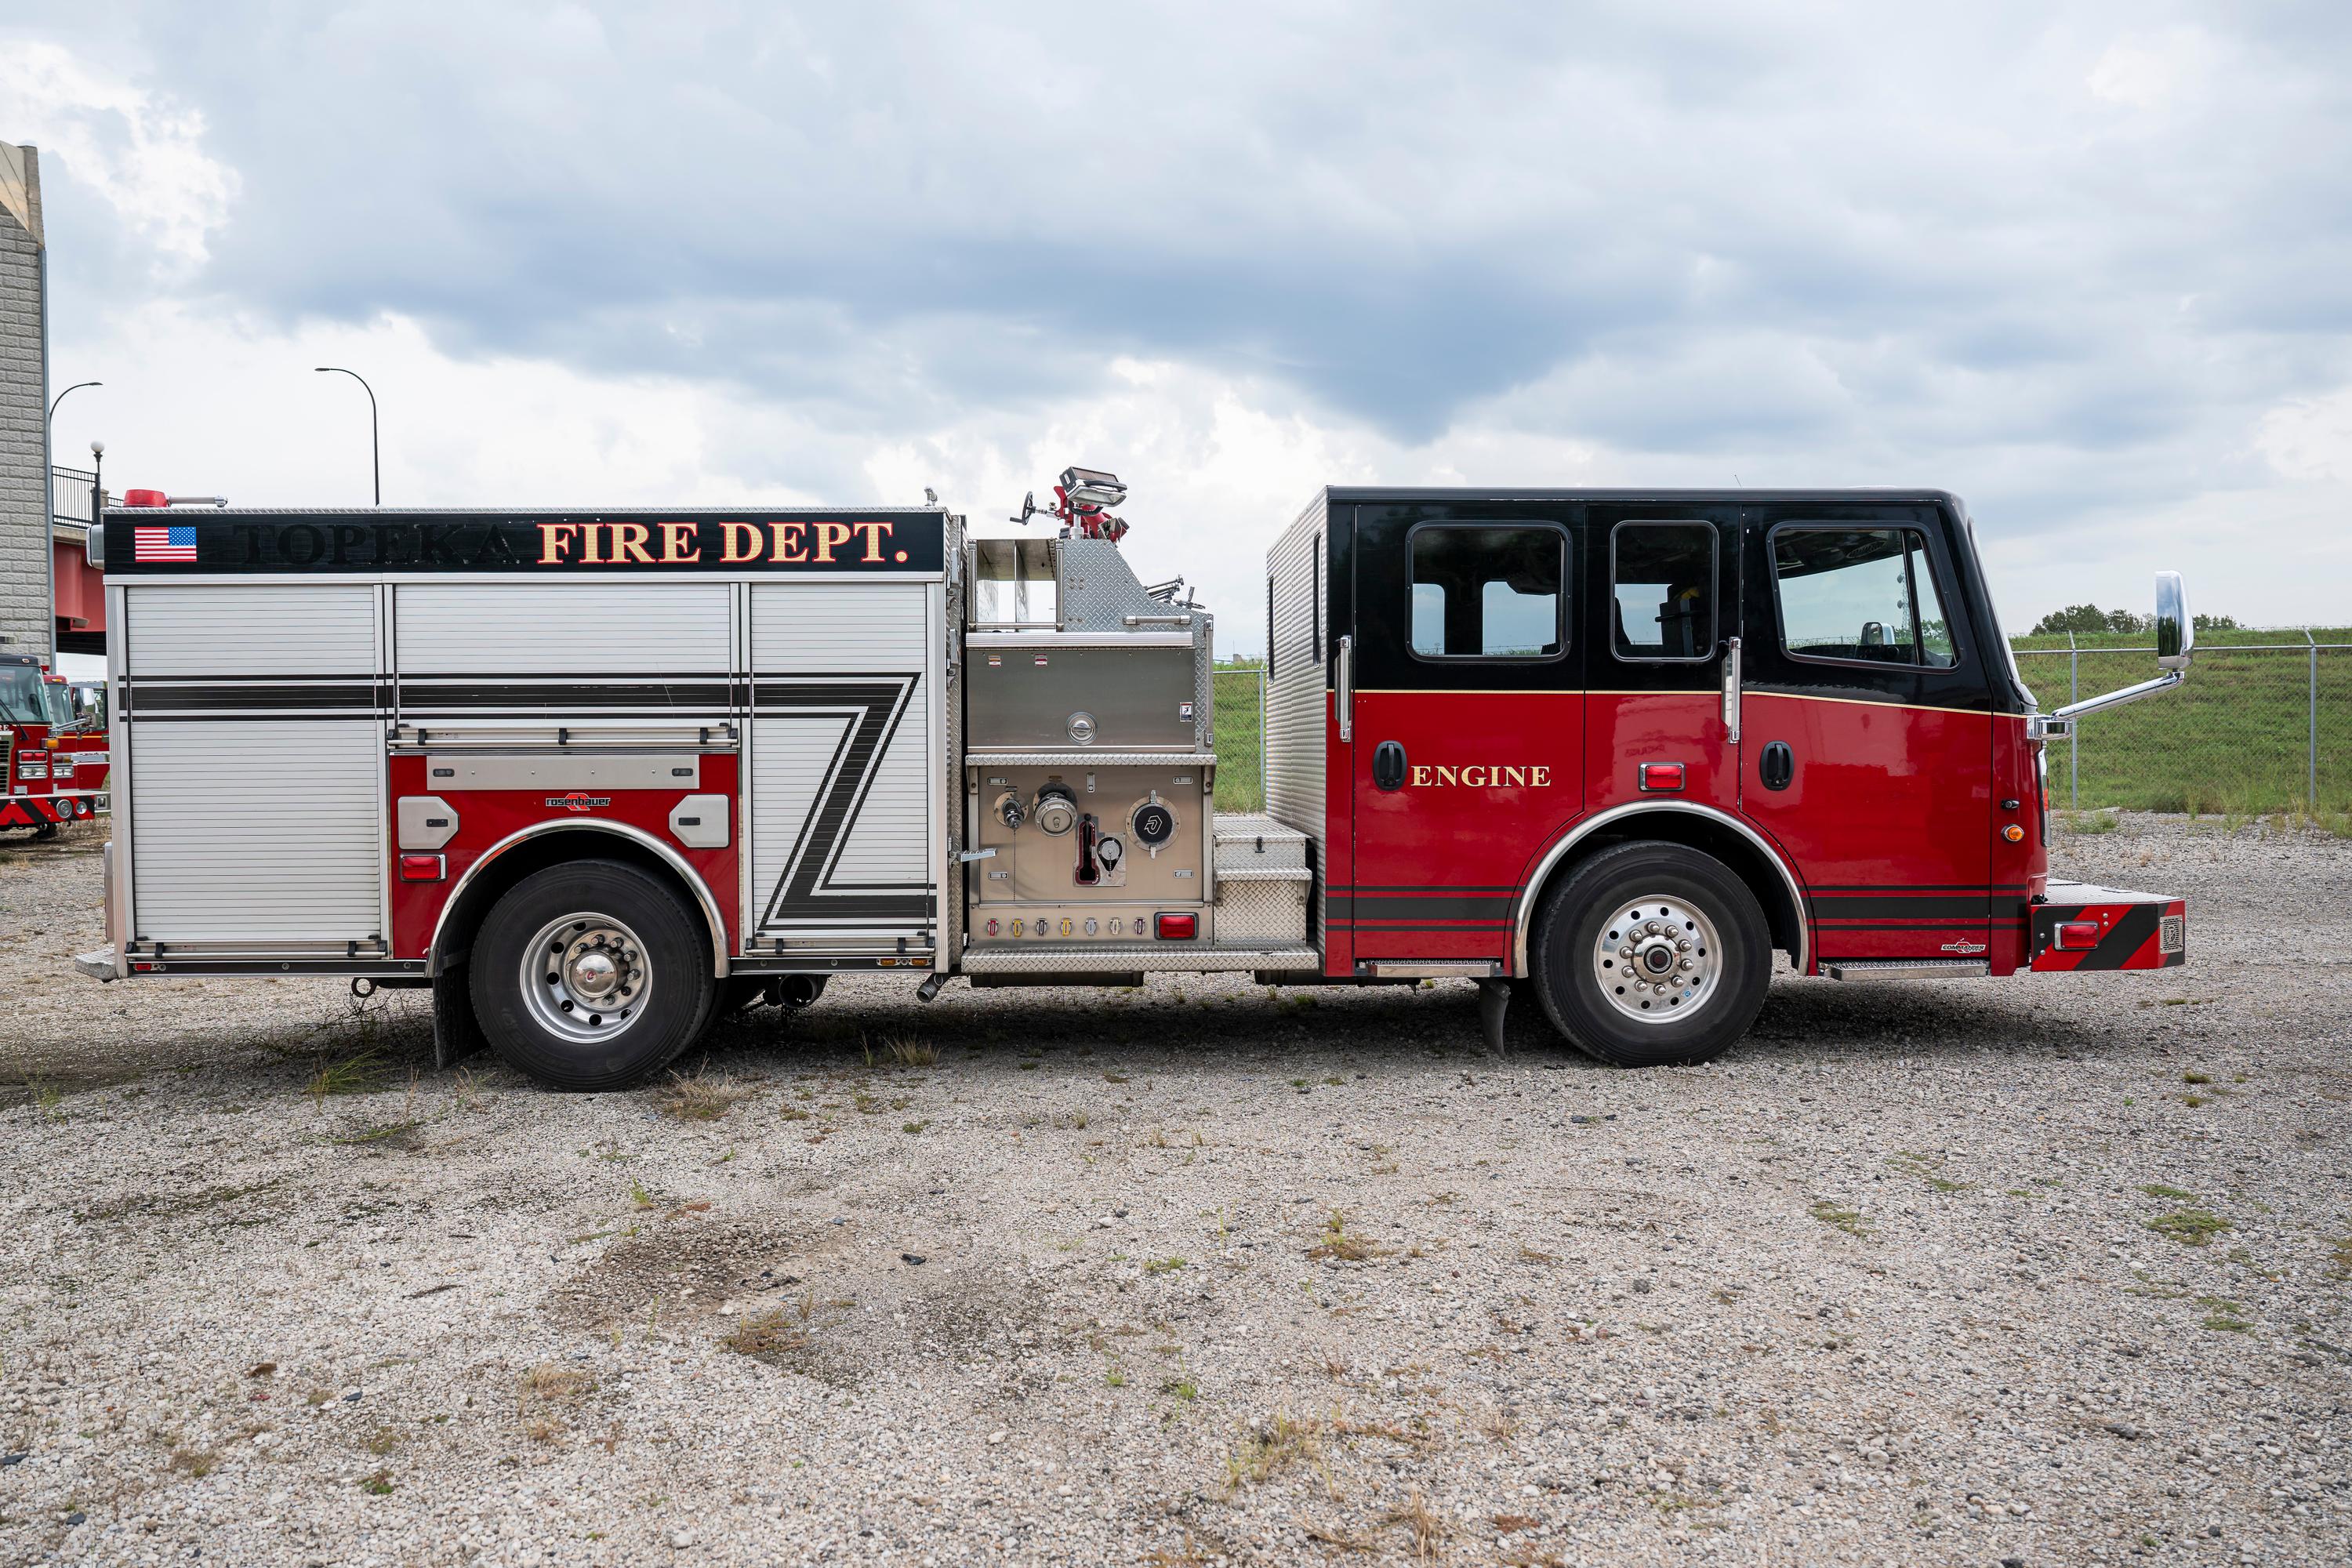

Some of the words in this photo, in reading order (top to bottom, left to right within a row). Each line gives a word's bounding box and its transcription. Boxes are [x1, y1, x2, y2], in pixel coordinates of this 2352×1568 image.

[233, 524, 519, 564] TOPEKA
[536, 522, 701, 564] FIRE
[719, 521, 908, 563] DEPT.
[1410, 764, 1552, 787] ENGINE
[546, 796, 610, 806] rosenbauer
